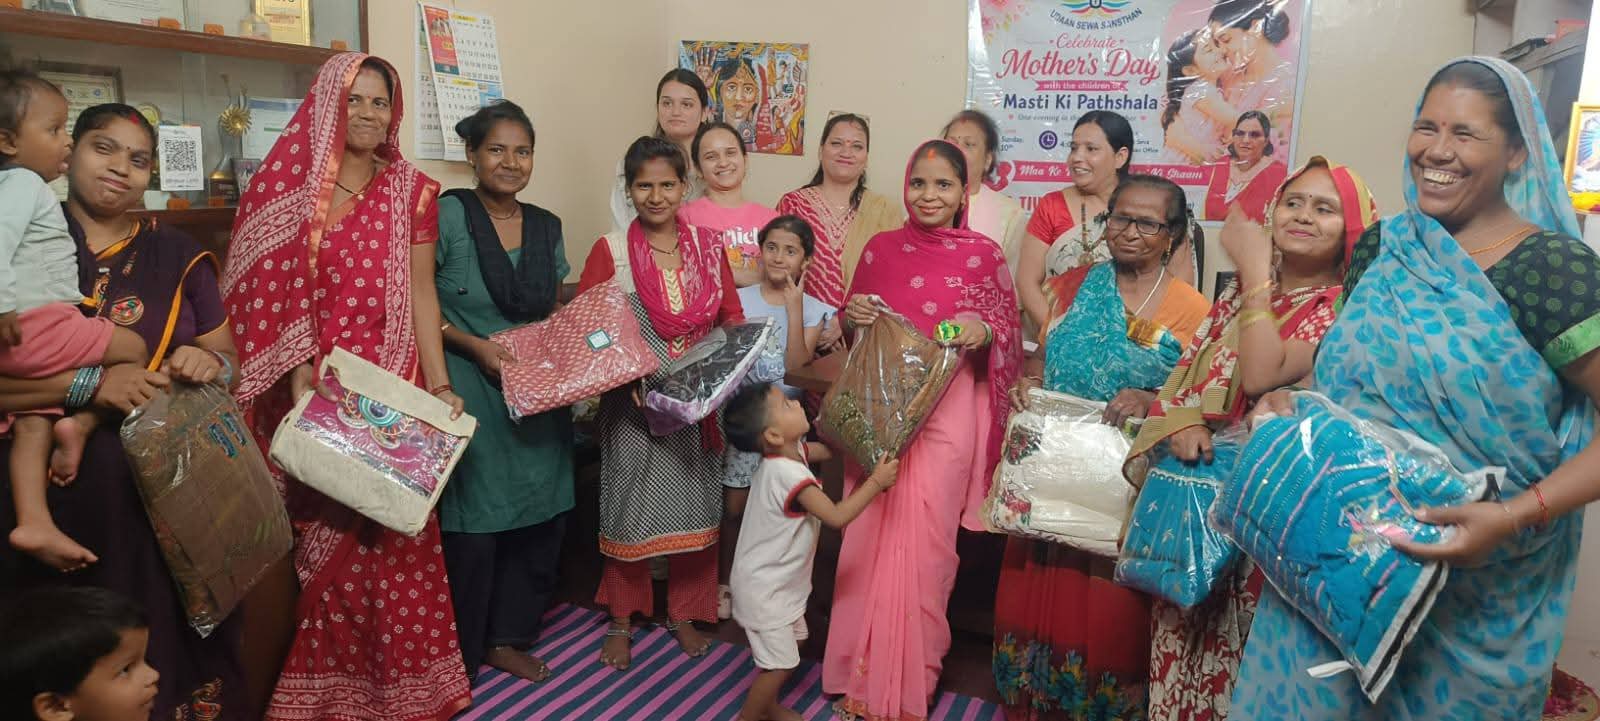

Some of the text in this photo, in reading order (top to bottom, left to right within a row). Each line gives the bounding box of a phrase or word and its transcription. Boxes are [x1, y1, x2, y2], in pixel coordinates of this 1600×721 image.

[1076, 21, 1099, 30] SEWA
[1056, 32, 1118, 48] Celebrate
[996, 48, 1160, 86] Mother's Day
[1003, 94, 1158, 110] Masti Ki Pathshala
